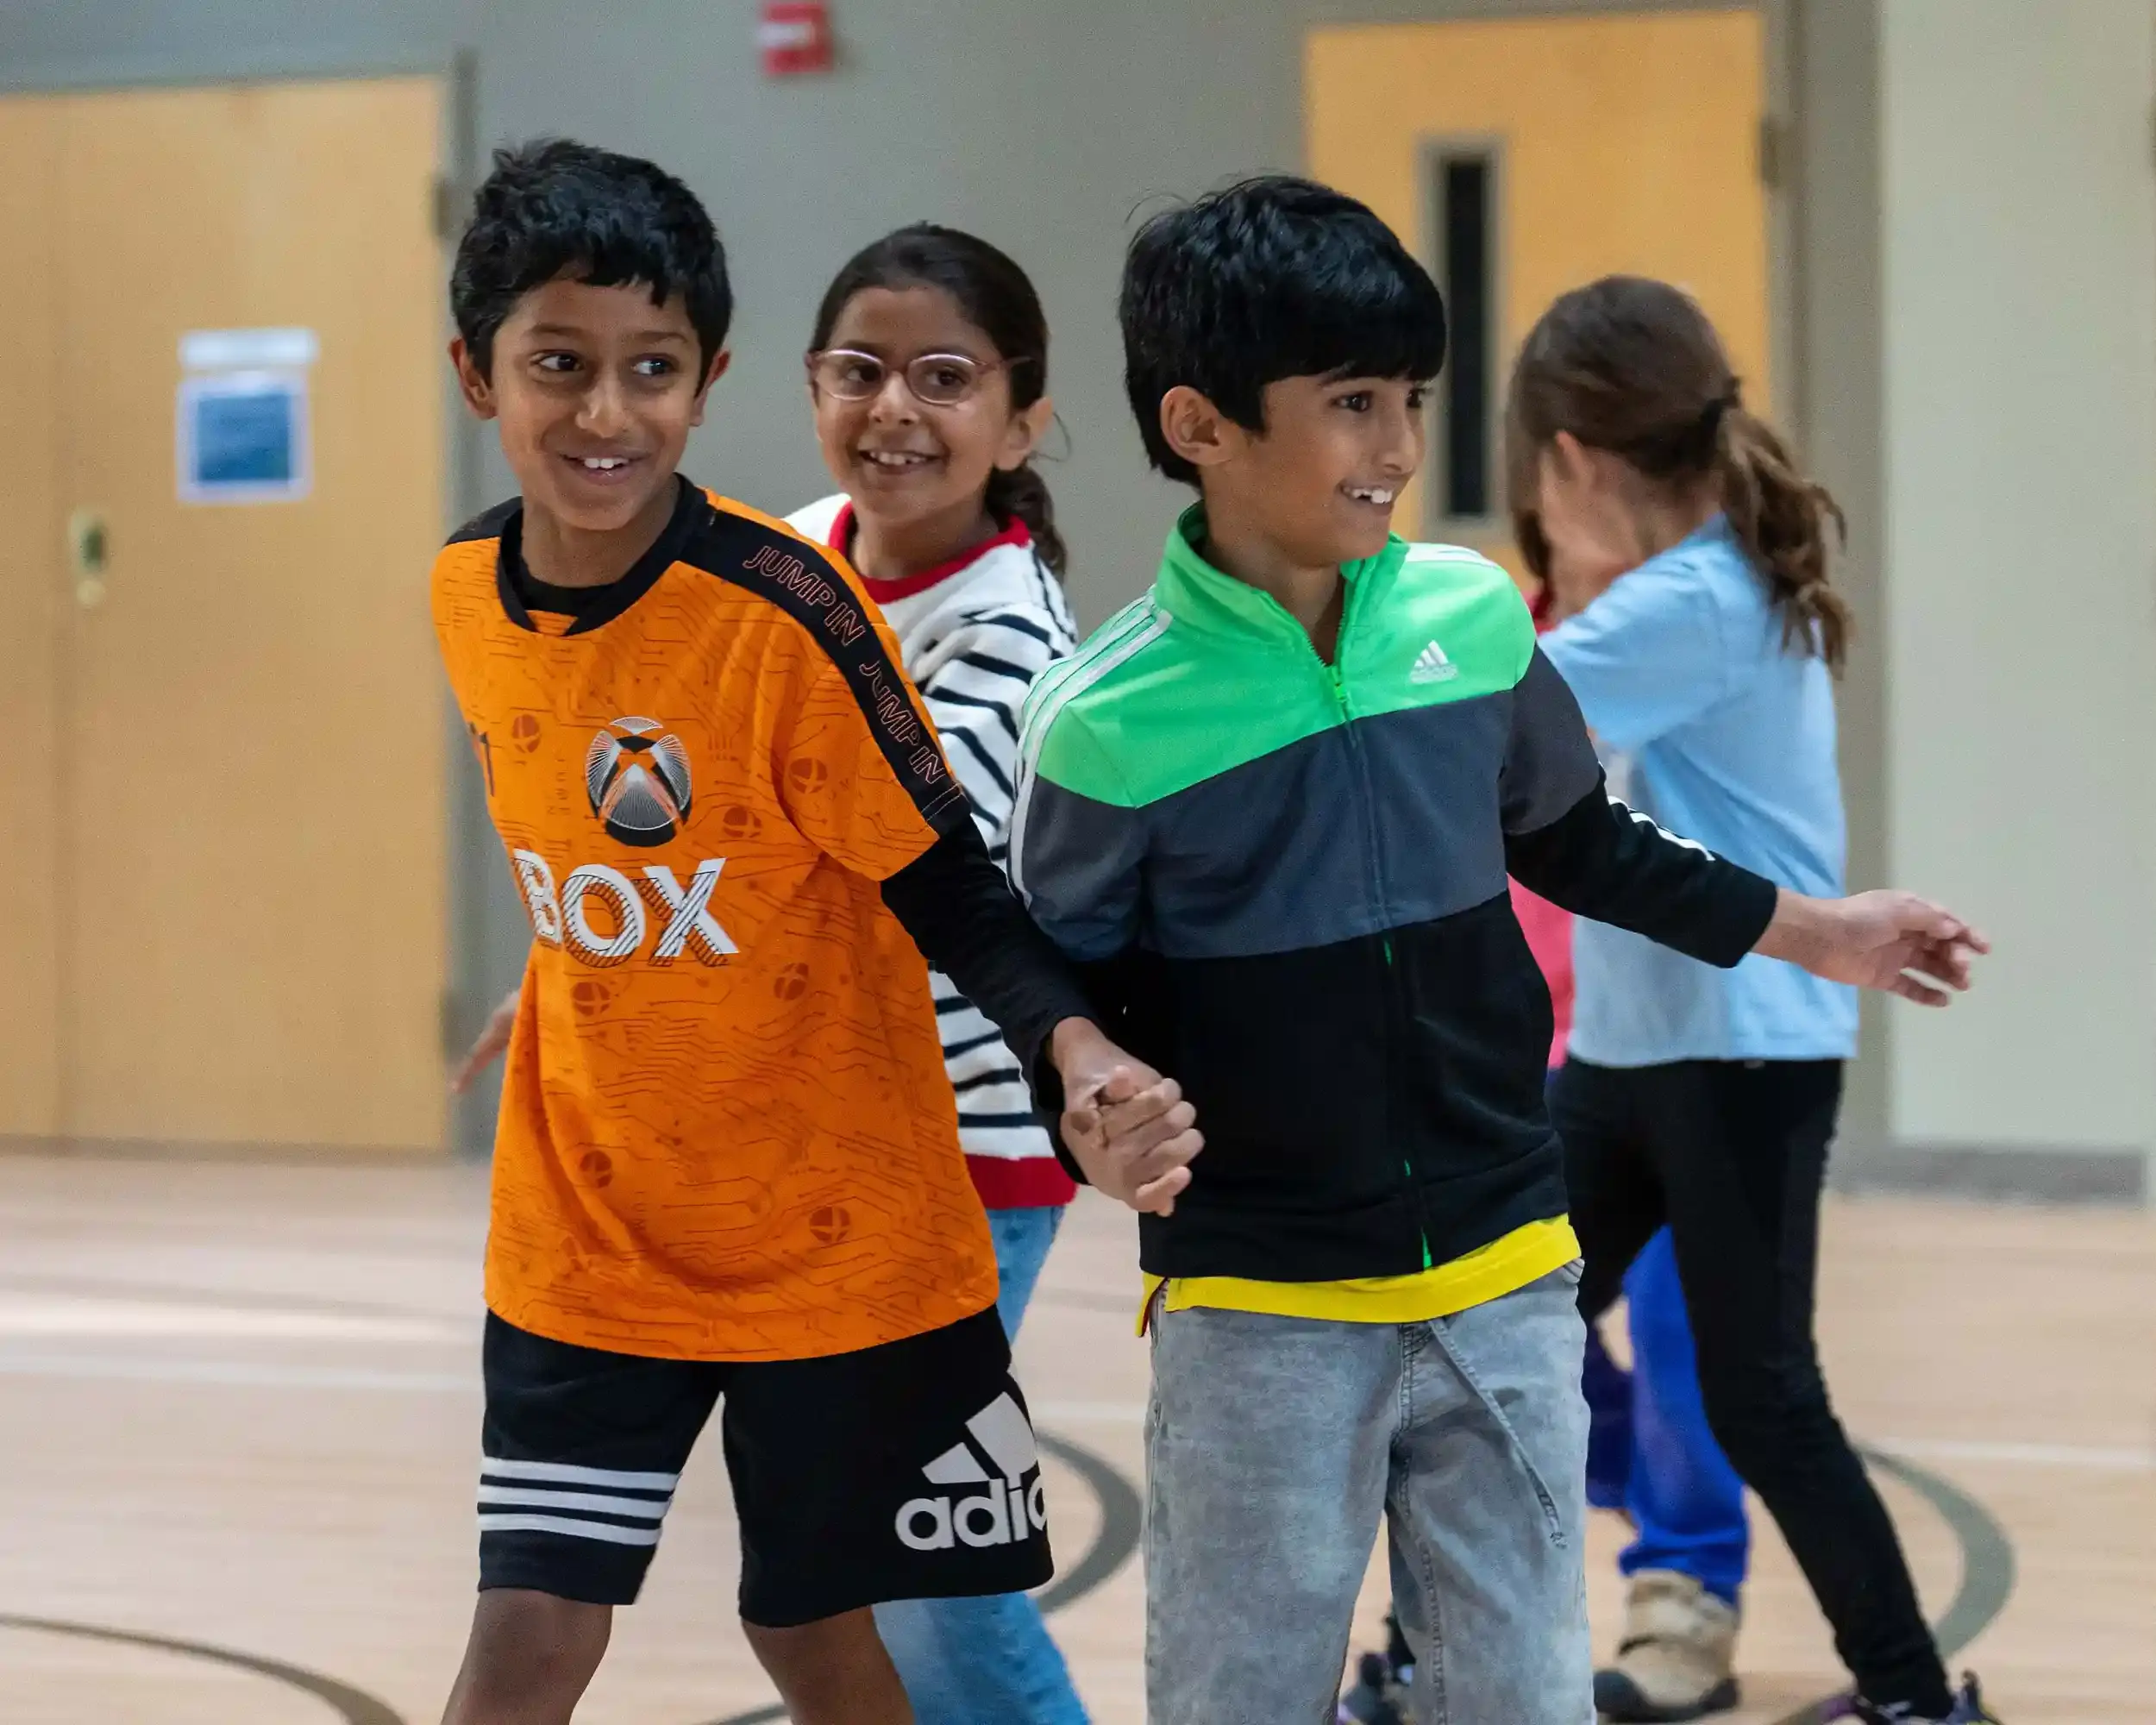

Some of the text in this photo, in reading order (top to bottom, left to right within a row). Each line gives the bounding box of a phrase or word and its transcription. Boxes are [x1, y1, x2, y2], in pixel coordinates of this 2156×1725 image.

[743, 545, 866, 647] JUMP IN
[859, 661, 945, 785] JUMP IN
